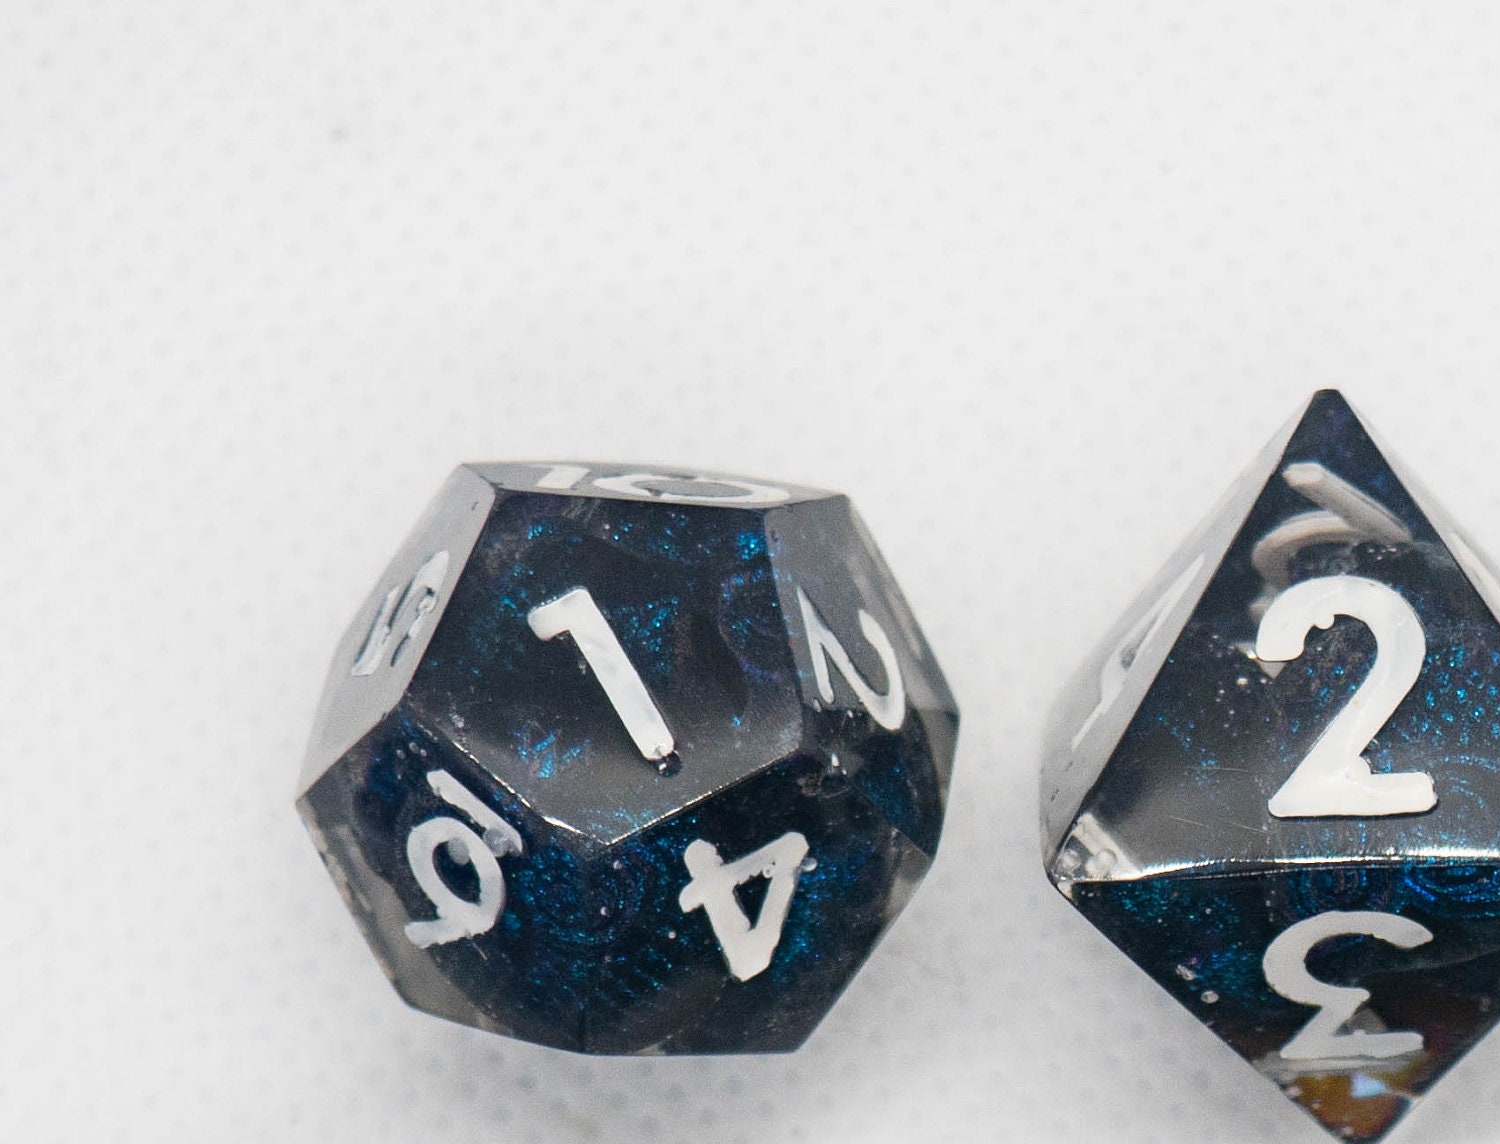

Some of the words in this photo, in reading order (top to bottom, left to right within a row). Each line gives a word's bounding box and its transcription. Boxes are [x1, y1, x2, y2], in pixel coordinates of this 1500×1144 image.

[533, 465, 789, 502] 10
[528, 588, 674, 760] 1
[798, 587, 905, 729] 2
[1256, 575, 1438, 817] 2
[680, 832, 808, 981] 4
[1263, 911, 1434, 1058] 3
